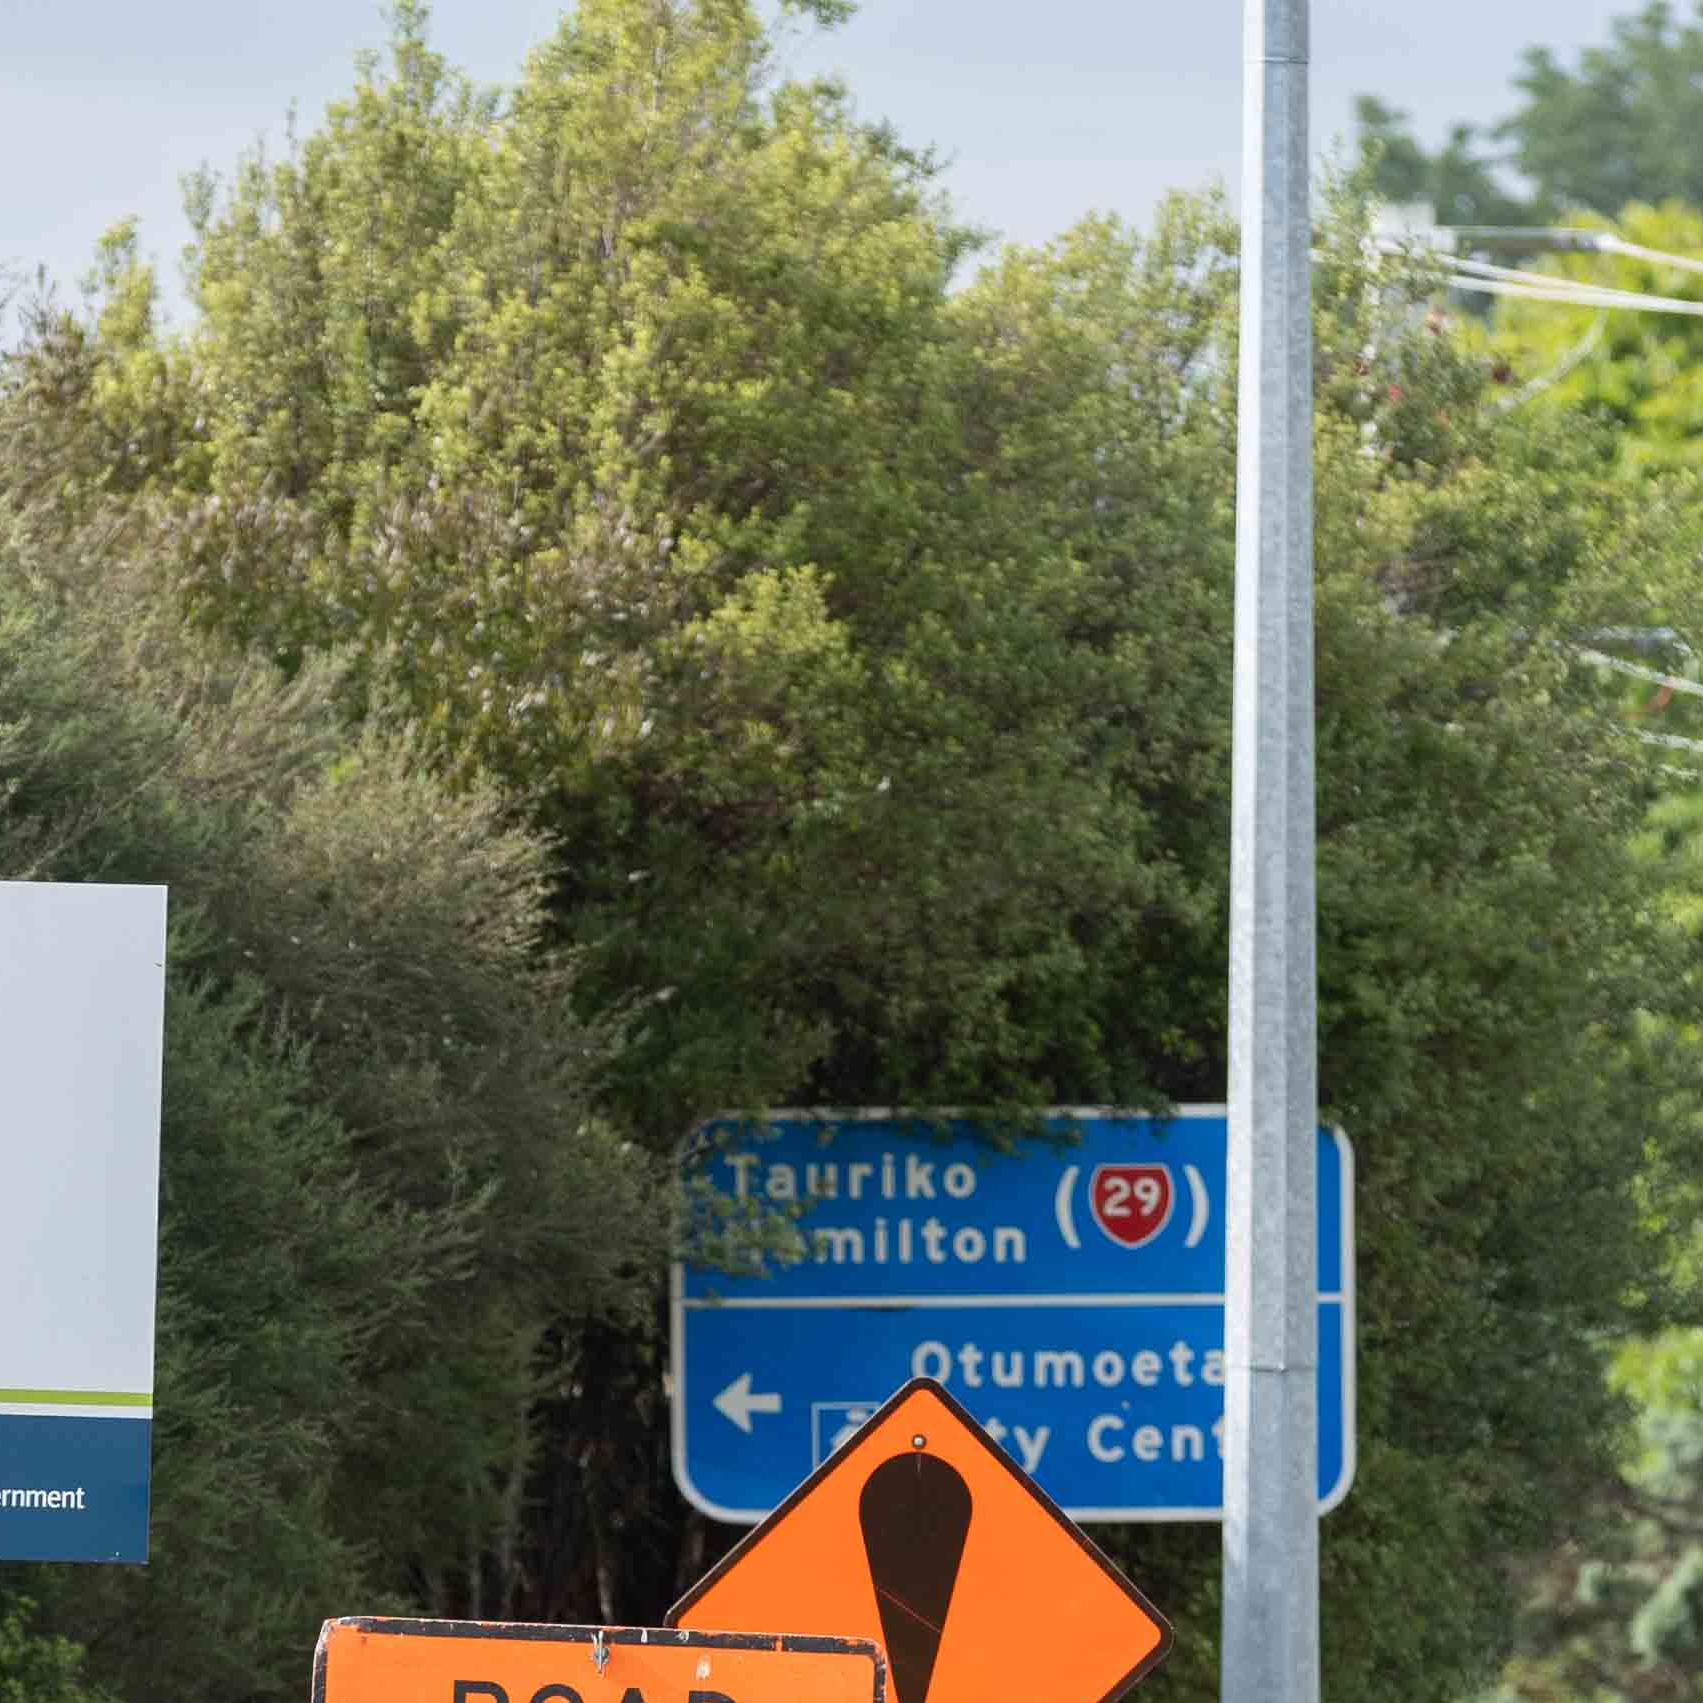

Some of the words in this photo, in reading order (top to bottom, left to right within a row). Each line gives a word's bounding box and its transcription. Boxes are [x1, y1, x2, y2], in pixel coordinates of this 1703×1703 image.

[724, 1152, 977, 1200] Tauriko
[757, 1216, 1028, 1265] milton
[910, 1340, 1227, 1389] Otumoeta
